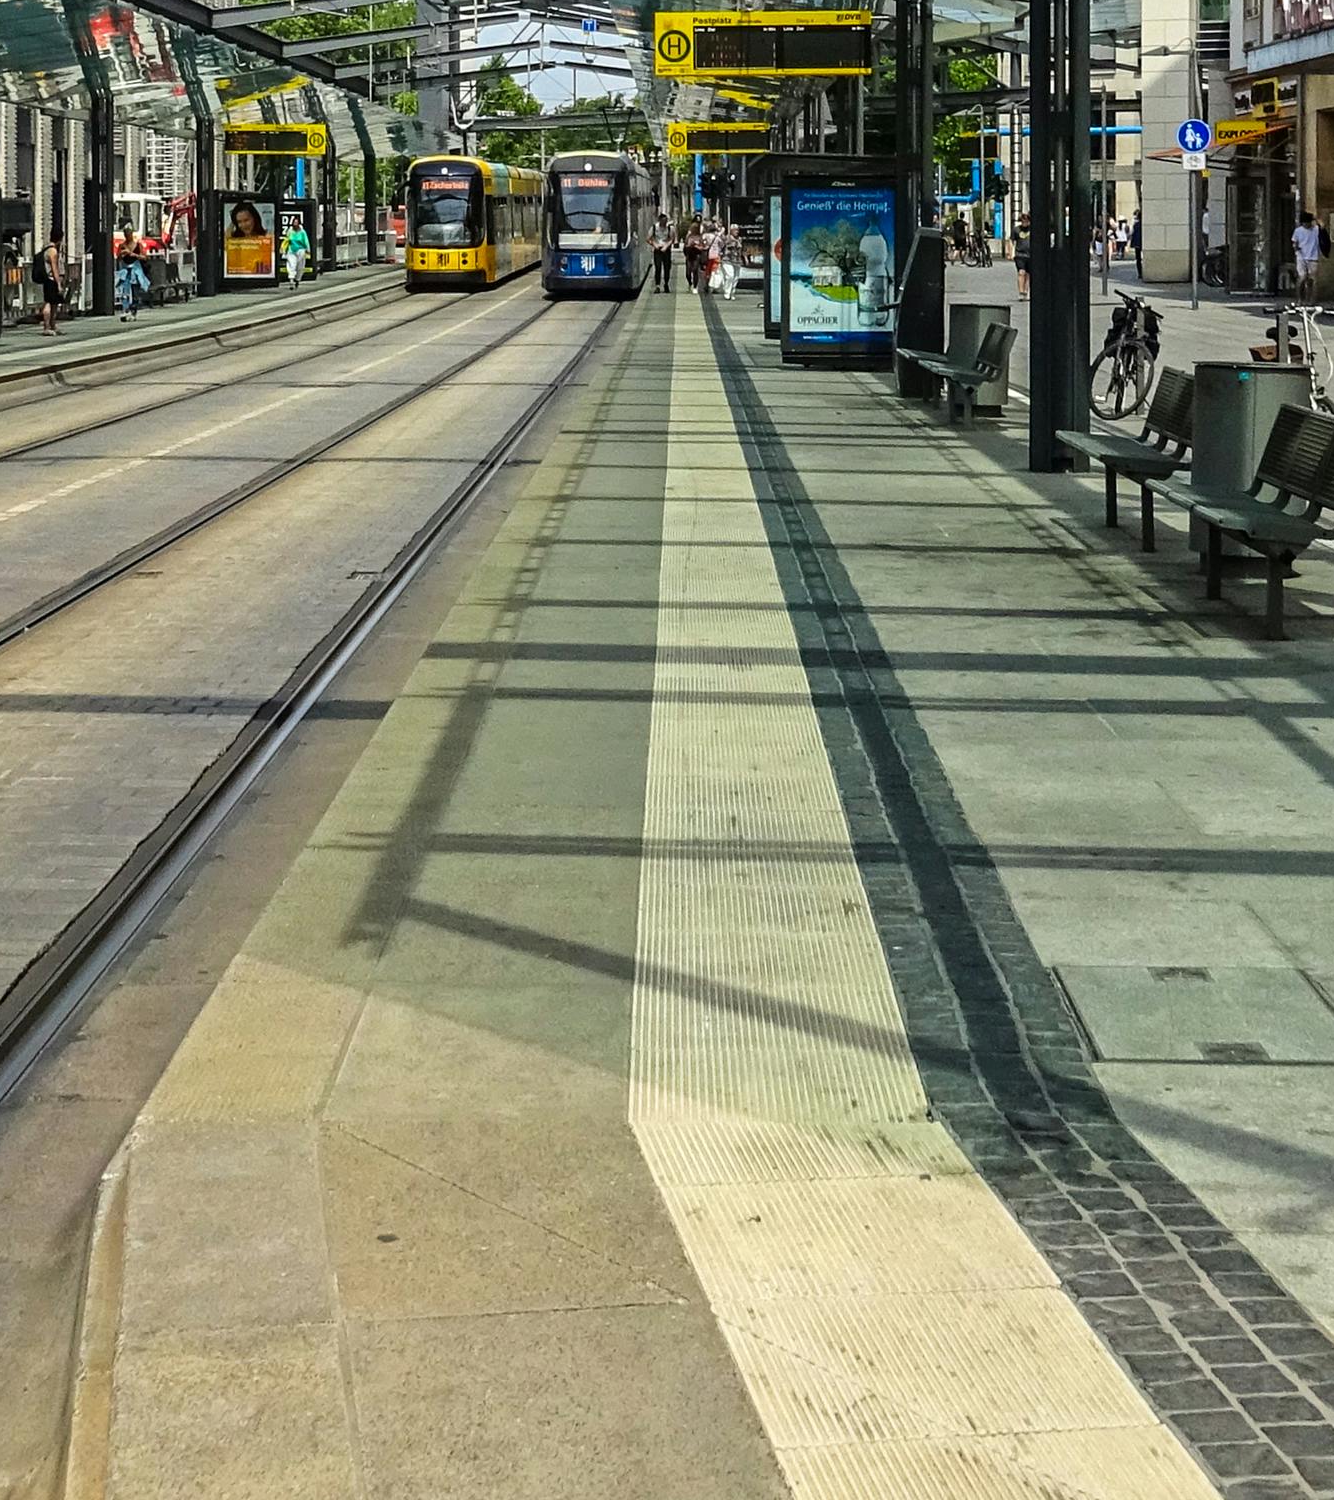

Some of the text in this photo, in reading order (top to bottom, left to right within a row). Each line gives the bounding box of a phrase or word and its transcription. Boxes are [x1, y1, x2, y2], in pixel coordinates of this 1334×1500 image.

[693, 16, 732, 26] Postplatz
[844, 13, 862, 21] DVB
[797, 200, 834, 211] Genieß'
[836, 201, 851, 211] die
[797, 316, 838, 324] OPPACHER
